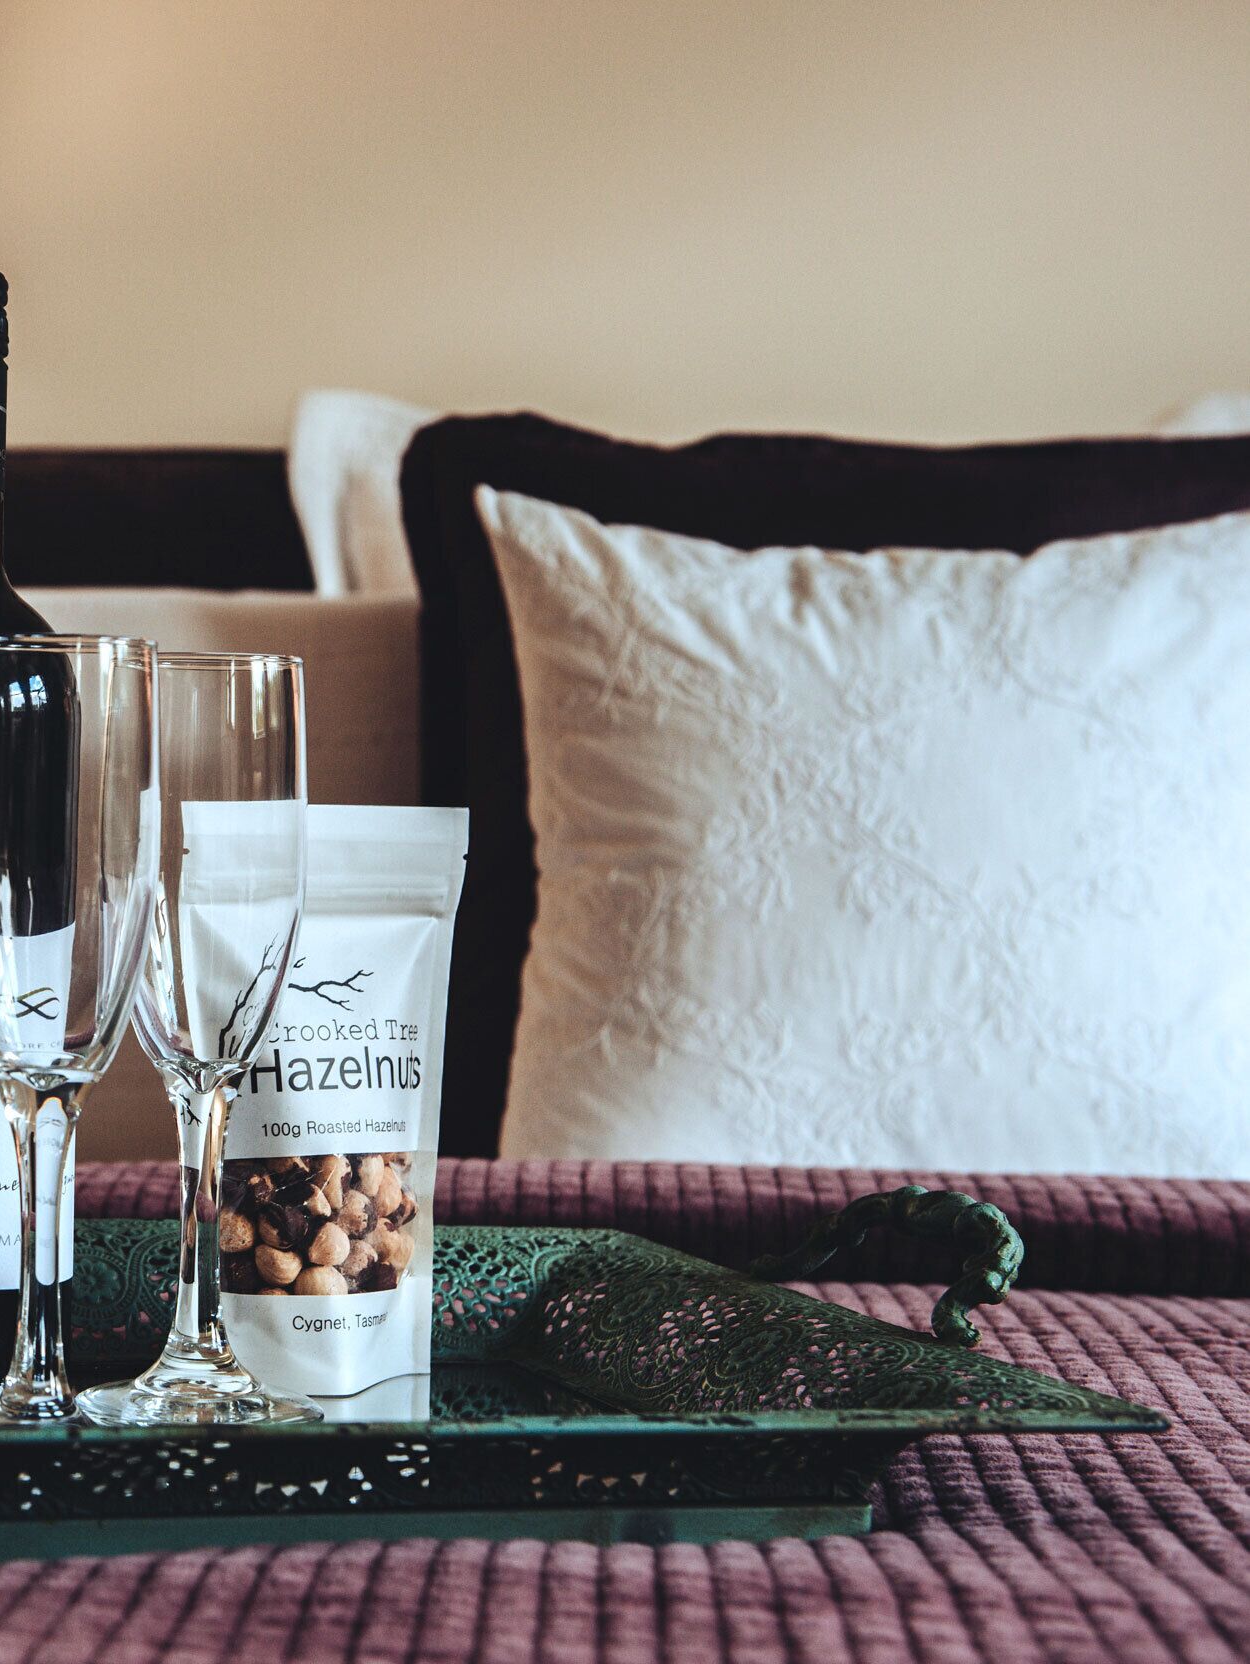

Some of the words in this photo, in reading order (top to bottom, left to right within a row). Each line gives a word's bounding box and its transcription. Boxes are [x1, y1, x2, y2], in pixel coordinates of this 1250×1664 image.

[385, 1019, 418, 1041] Tree
[250, 1046, 421, 1094] Hazelnuts
[261, 1122, 301, 1138] 100g
[306, 1118, 361, 1134] Roasted
[365, 1118, 406, 1132] Hazelnuts
[292, 1315, 351, 1332] Cygnet,
